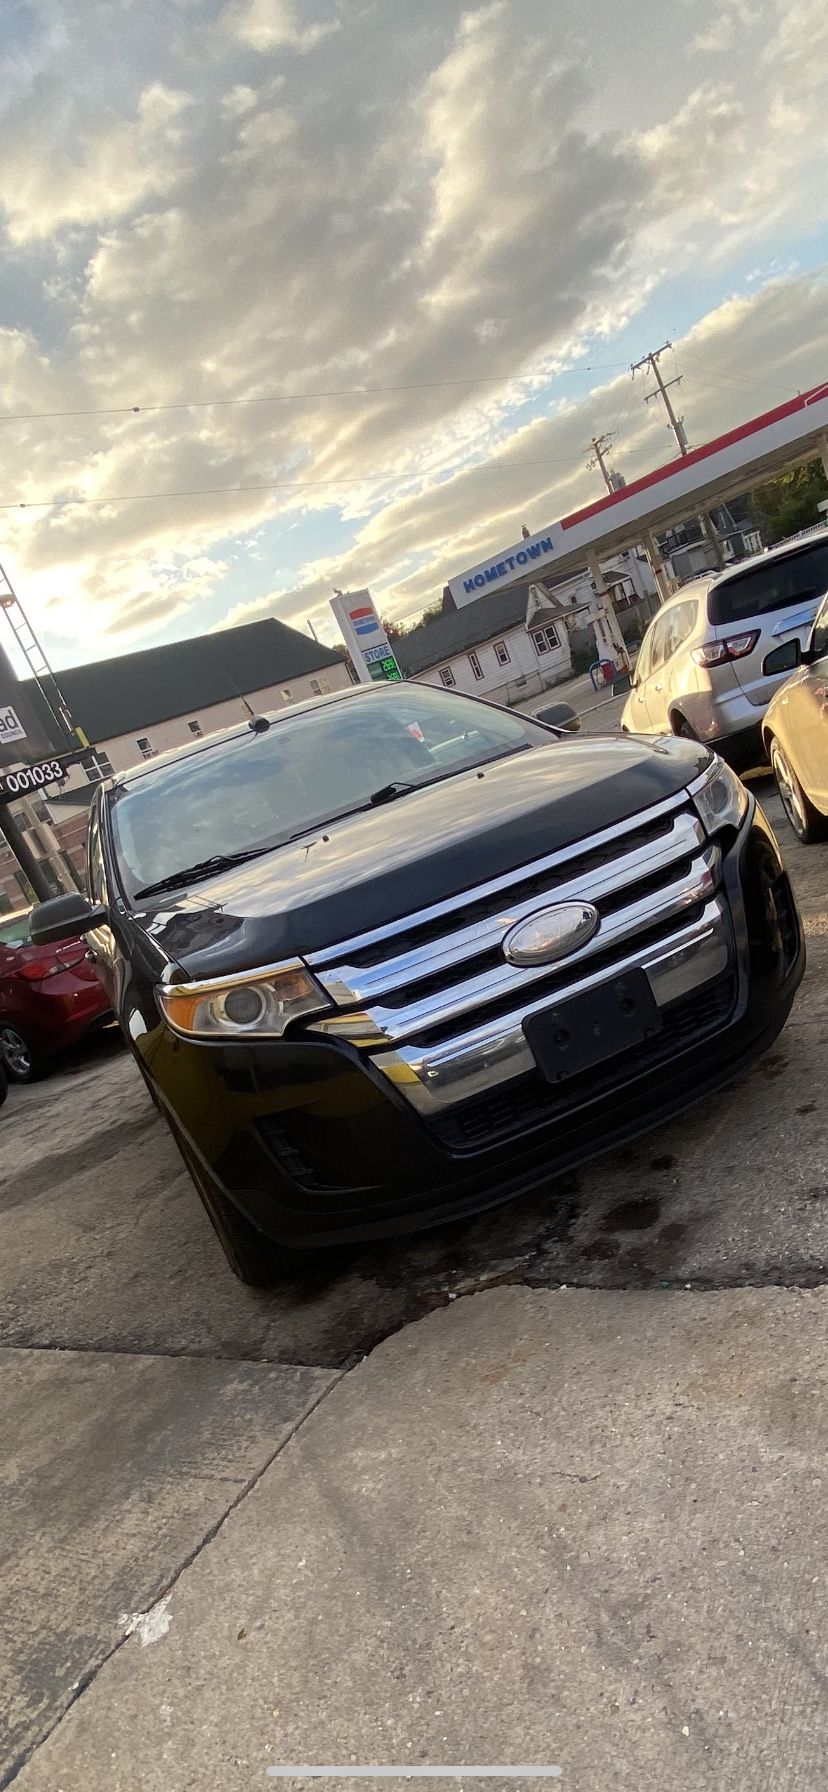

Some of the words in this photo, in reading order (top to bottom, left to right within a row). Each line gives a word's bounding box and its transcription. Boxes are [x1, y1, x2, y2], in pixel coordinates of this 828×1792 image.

[463, 537, 554, 593] HOMETOWN
[364, 646, 390, 662] STORE
[6, 761, 63, 792] 001033
